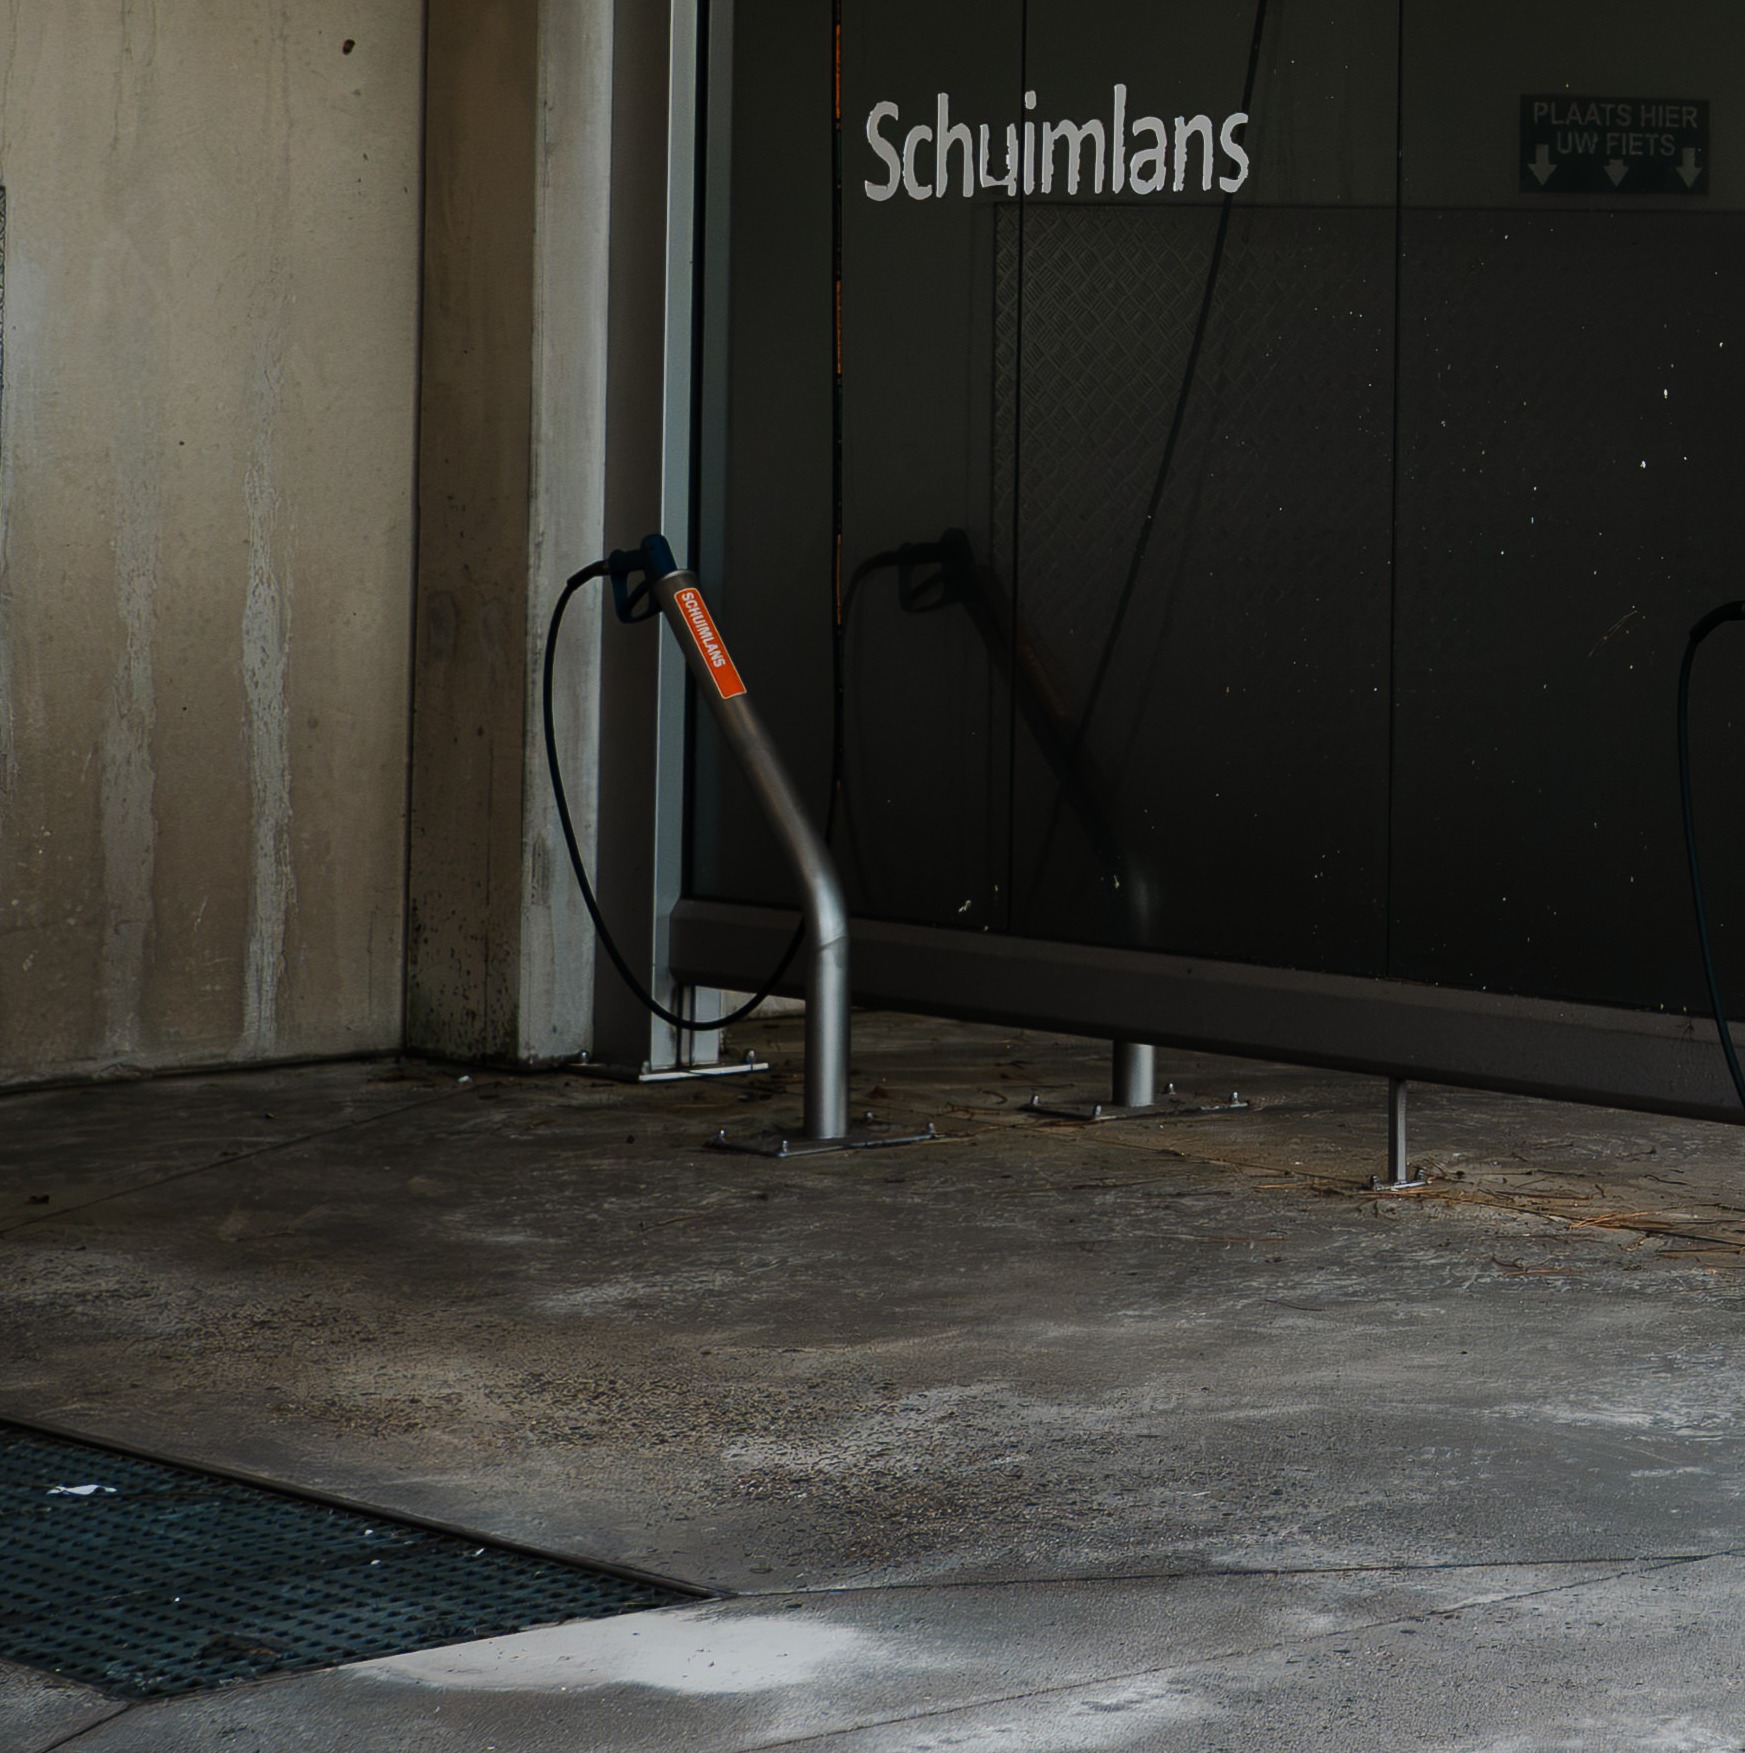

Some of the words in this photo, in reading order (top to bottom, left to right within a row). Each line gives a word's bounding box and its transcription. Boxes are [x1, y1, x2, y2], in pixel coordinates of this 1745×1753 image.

[1533, 101, 1632, 127] PLAATS
[1640, 104, 1698, 128] HIER
[864, 83, 1251, 202] Schuimlans
[1556, 130, 1598, 154] UW
[1606, 133, 1676, 156] FIETS
[681, 592, 726, 668] SCHUIMLANS
